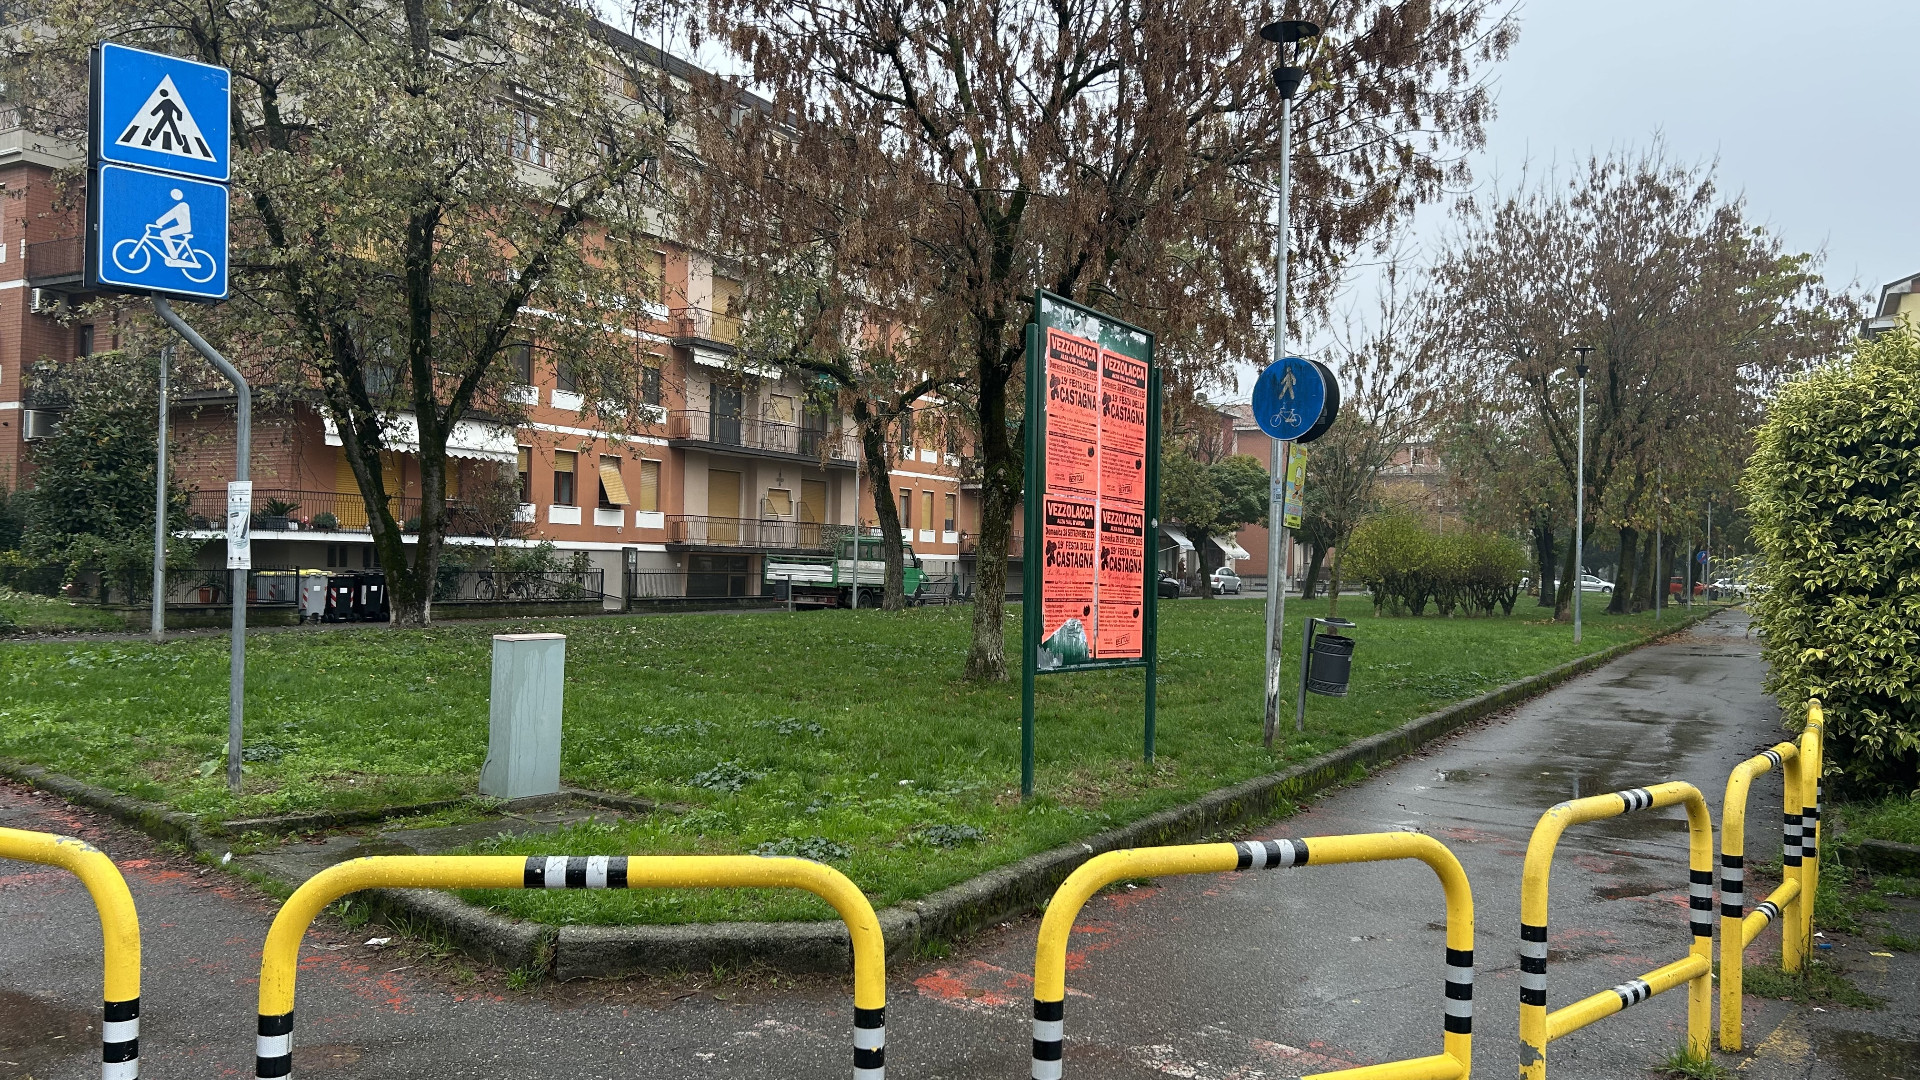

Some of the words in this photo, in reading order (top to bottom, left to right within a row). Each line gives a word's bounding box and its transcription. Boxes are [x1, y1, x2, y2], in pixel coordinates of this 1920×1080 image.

[1051, 335, 1097, 363] VEZZOLACCA
[1104, 356, 1145, 380] VEZZOLACCA
[1069, 378, 1083, 391] FESTA
[1083, 382, 1097, 394] DELLA
[1060, 387, 1097, 411] CASTAGNA
[1119, 395, 1131, 407] FESTA
[1132, 400, 1145, 410] DELLA
[1110, 404, 1145, 426] CASTAGNA
[1047, 502, 1093, 520] VEZZOLACCA
[1102, 510, 1141, 528] VEZZOLACCA
[1065, 541, 1079, 551] FESTA
[1080, 542, 1094, 551] DELLA
[1118, 547, 1129, 557] FESTA
[1130, 549, 1142, 557] DELLA
[1056, 551, 1093, 568] CASTAGNA
[1110, 557, 1142, 574] CASTAGNA
